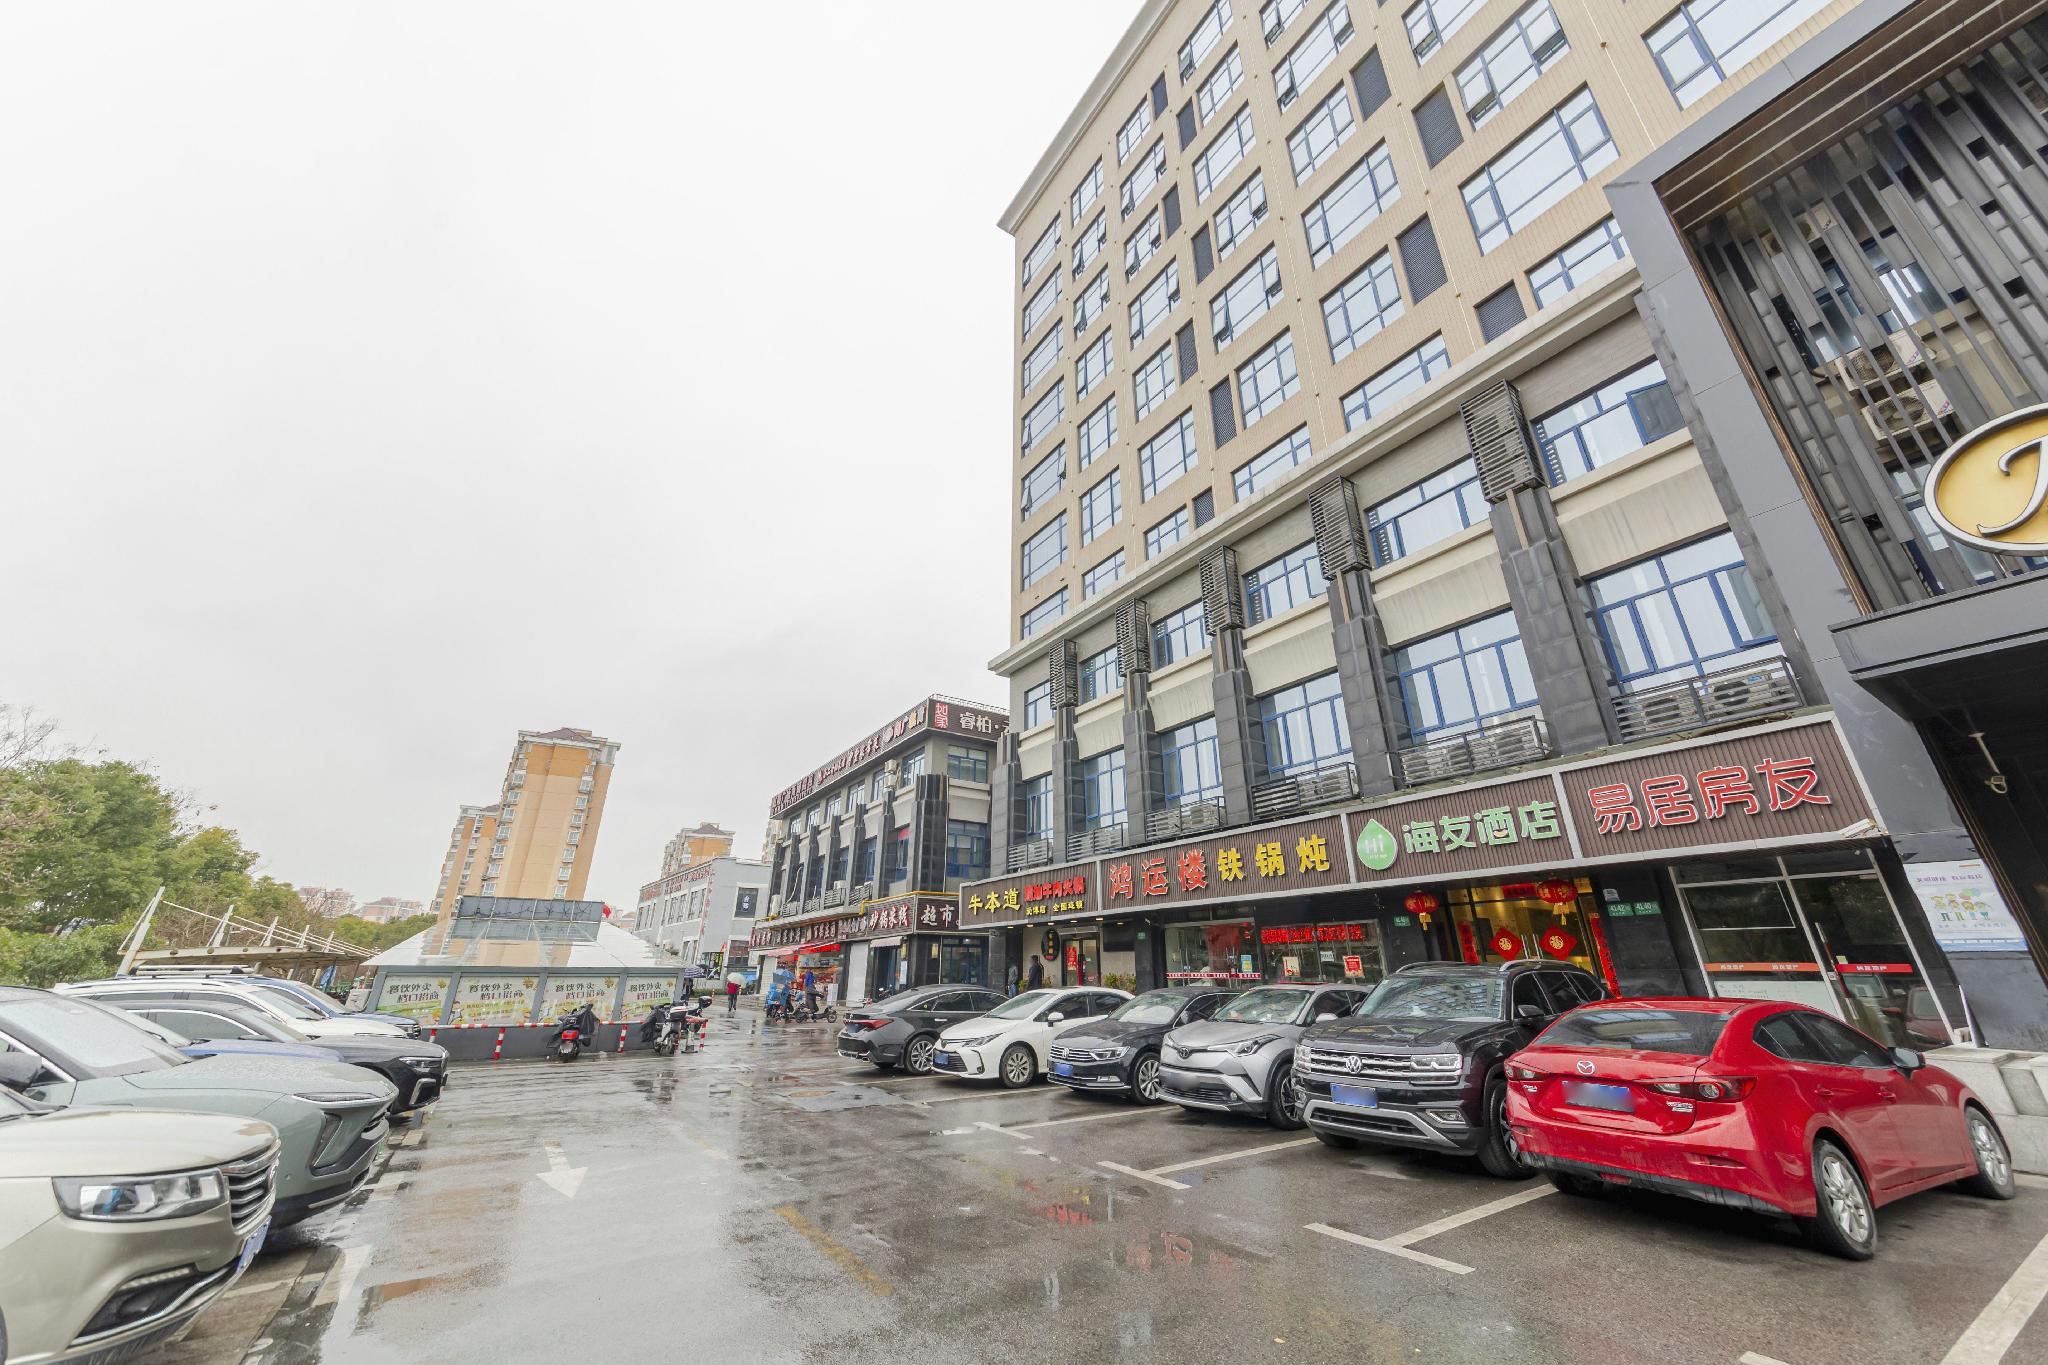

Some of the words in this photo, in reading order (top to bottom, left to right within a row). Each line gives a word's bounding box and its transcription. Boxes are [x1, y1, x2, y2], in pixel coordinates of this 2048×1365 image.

[934, 701, 948, 729] 如家
[1588, 757, 1832, 835] 易居房友
[1402, 800, 1562, 853] 海友酒店
[1110, 848, 1208, 900] 鸿运楼
[1217, 834, 1330, 882] 铁锅炖
[921, 904, 955, 928] 超市
[968, 887, 1021, 916] 牛本道
